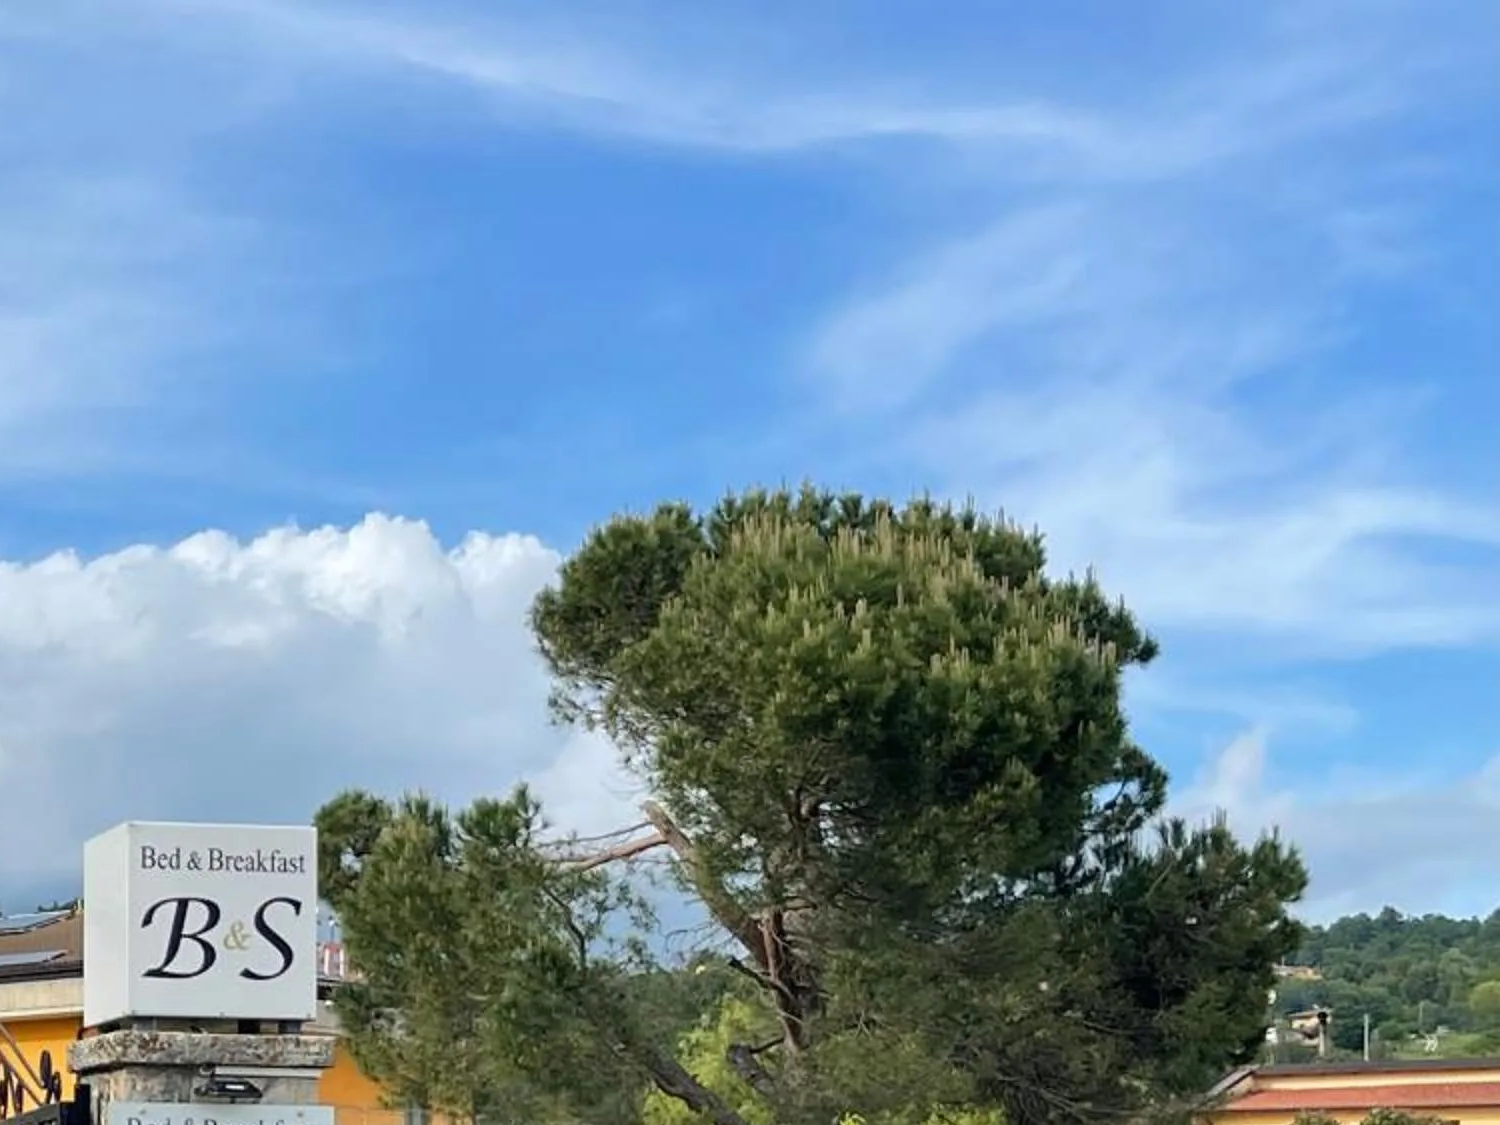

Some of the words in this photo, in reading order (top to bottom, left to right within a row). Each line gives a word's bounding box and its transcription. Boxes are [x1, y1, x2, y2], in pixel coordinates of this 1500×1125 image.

[141, 846, 181, 871] Bed
[187, 851, 203, 871] &
[207, 848, 305, 873] Breakfast
